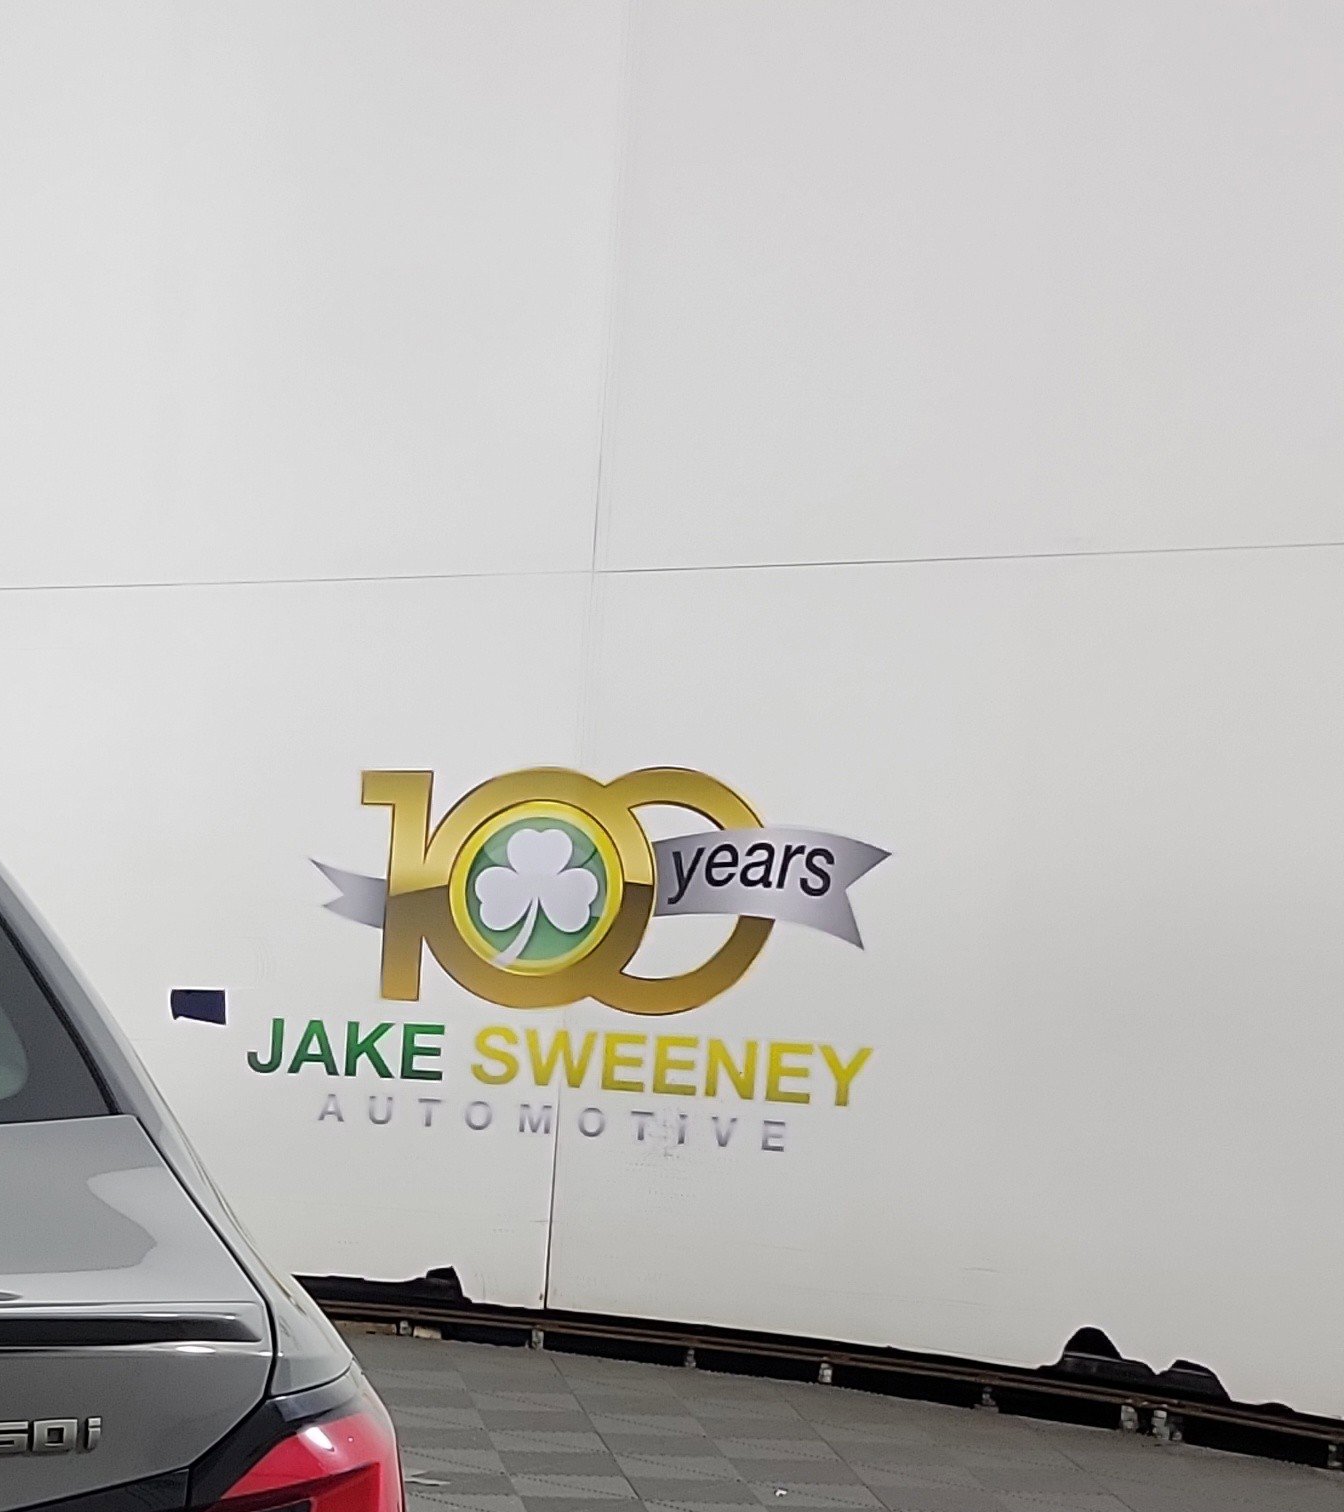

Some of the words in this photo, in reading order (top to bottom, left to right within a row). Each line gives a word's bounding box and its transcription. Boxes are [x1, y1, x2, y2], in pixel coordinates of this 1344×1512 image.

[361, 766, 775, 1015] 100
[669, 841, 834, 904] years
[247, 1019, 444, 1081] JAKE
[472, 1027, 873, 1106] SWEENEY
[318, 1094, 787, 1151] AUTOMOTIVE
